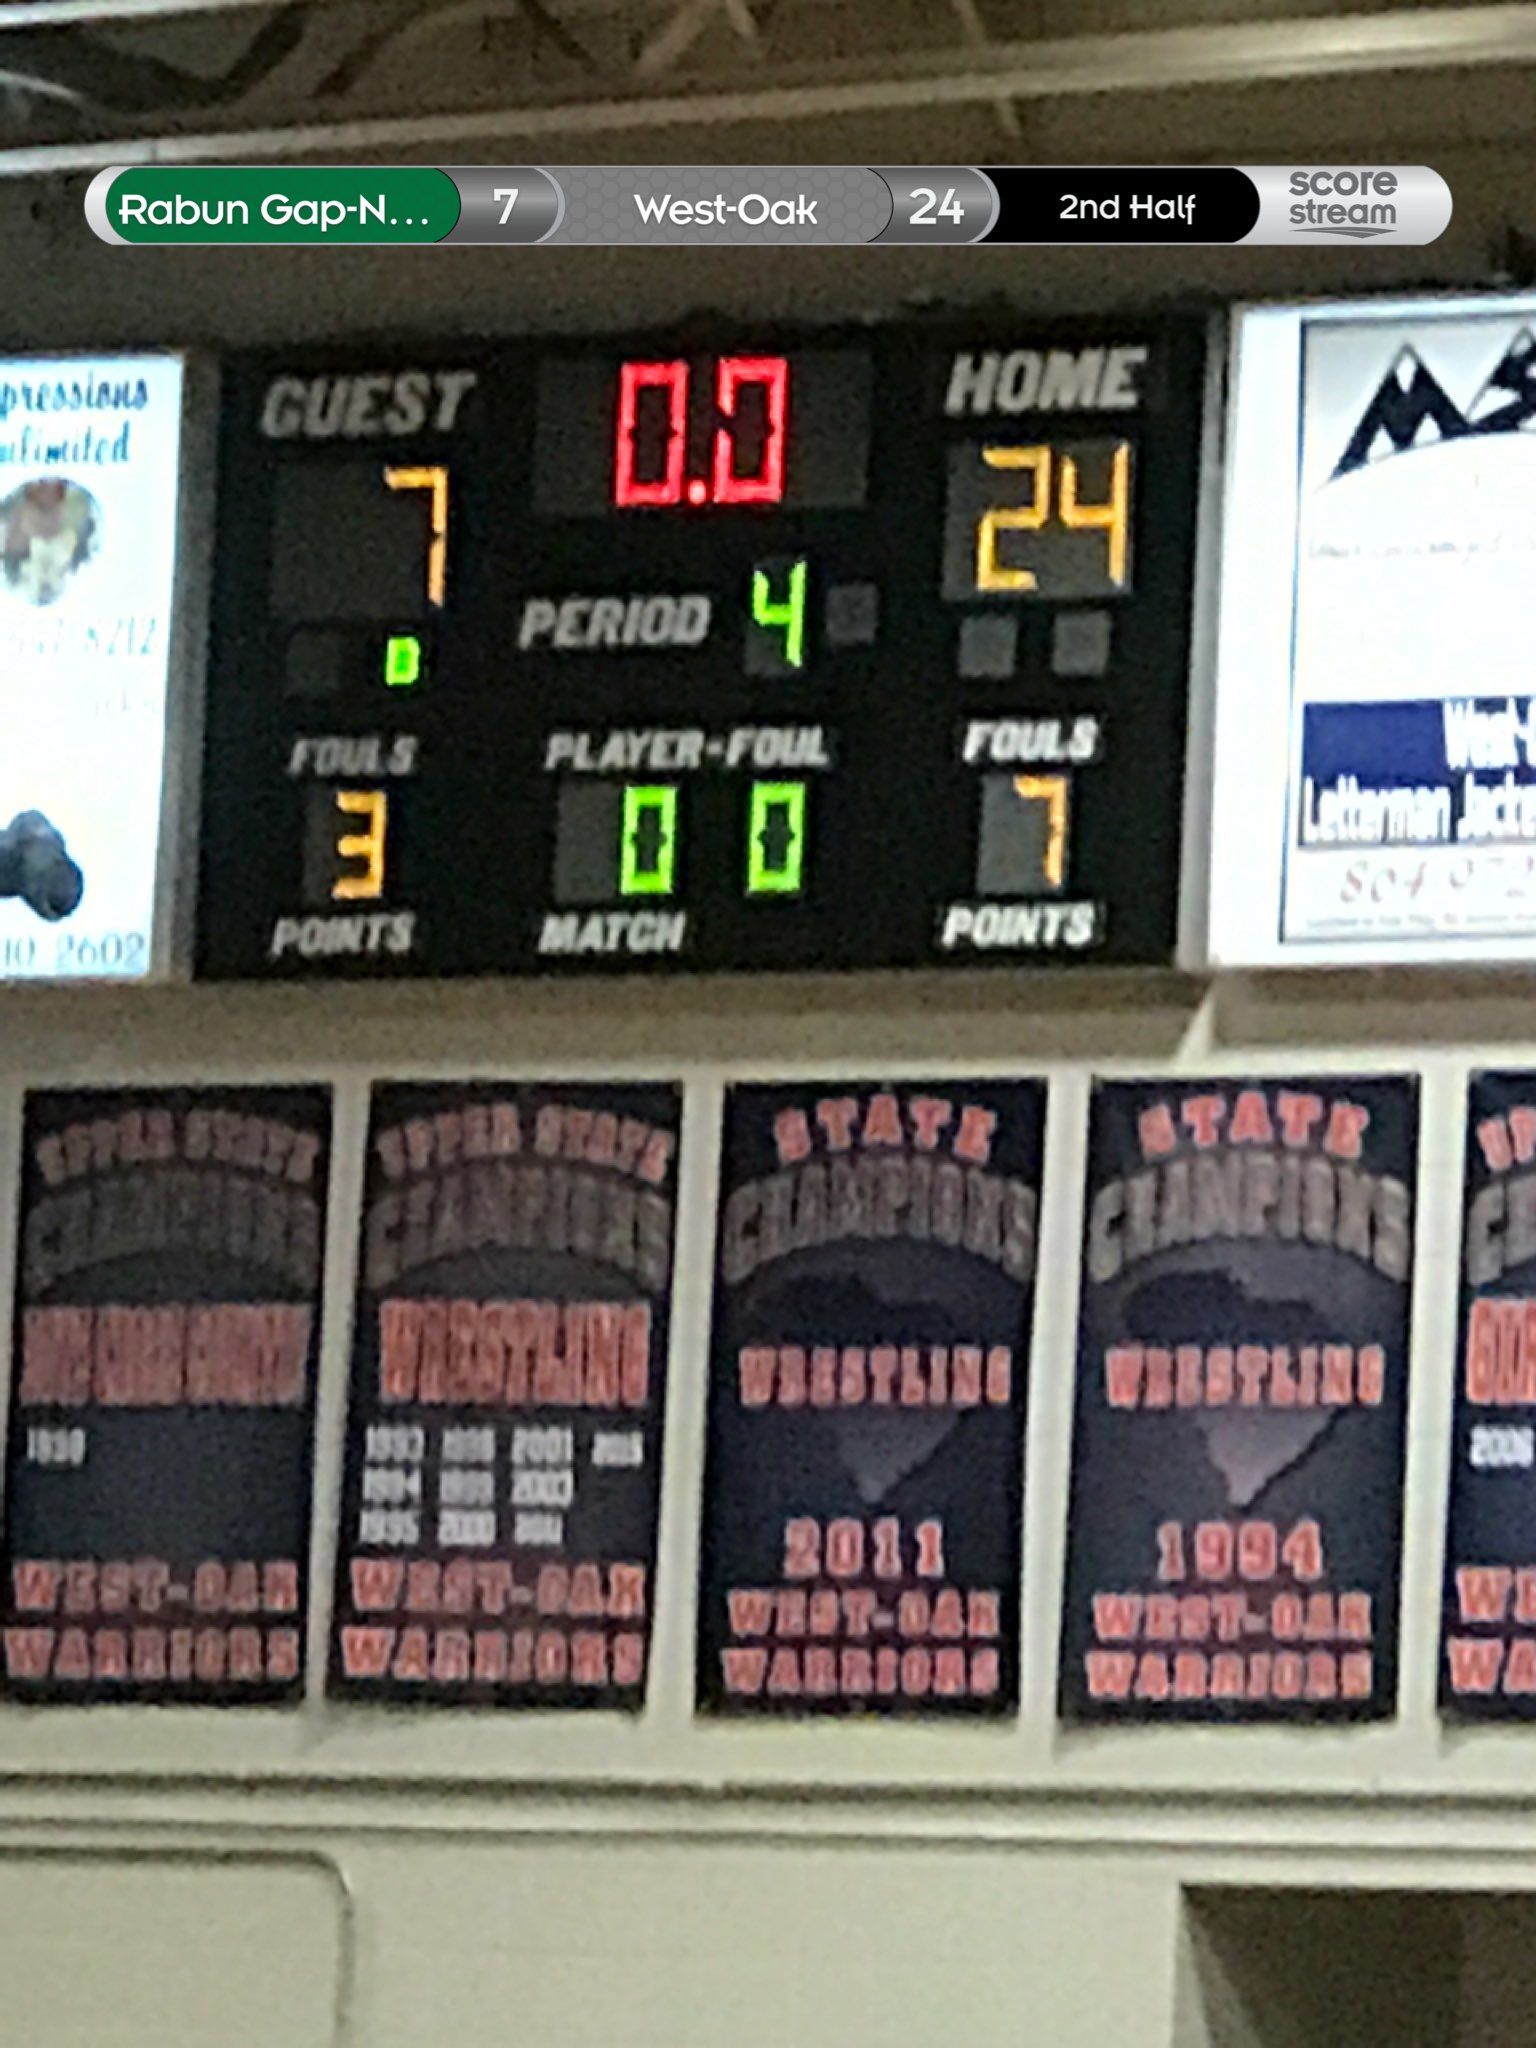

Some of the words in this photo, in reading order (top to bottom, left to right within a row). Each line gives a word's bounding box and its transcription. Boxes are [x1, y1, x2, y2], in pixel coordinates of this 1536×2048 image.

[259, 371, 478, 440] GUEST
[944, 345, 1149, 417] HOME
[613, 354, 788, 508] 0.0
[384, 465, 449, 607] 7
[975, 442, 1131, 591] 24
[518, 595, 712, 650] PERIOD
[752, 560, 807, 668] 4
[288, 735, 420, 777] FOULS
[542, 725, 830, 771] PLAYER-FOUL
[961, 717, 1100, 764] FOULS
[332, 789, 389, 900] 3
[619, 784, 678, 896] 0
[746, 781, 807, 893] 0
[1013, 774, 1069, 888] 7
[270, 911, 415, 958] POINTS
[537, 911, 688, 955] MATCH
[942, 903, 1096, 951] POINTS
[773, 1093, 998, 1165] STATE
[1137, 1089, 1370, 1158] STATE
[784, 1515, 946, 1578] 2011
[1156, 1517, 1324, 1581] 1994
[727, 1588, 999, 1638] WEST-OAK
[1092, 1591, 1372, 1642] WEST-OAK
[5, 1627, 299, 1681] WARRIORS
[342, 1626, 645, 1683] WARRIORS
[719, 1646, 999, 1697] WARRIORS
[1084, 1649, 1372, 1699] WARRIORS
